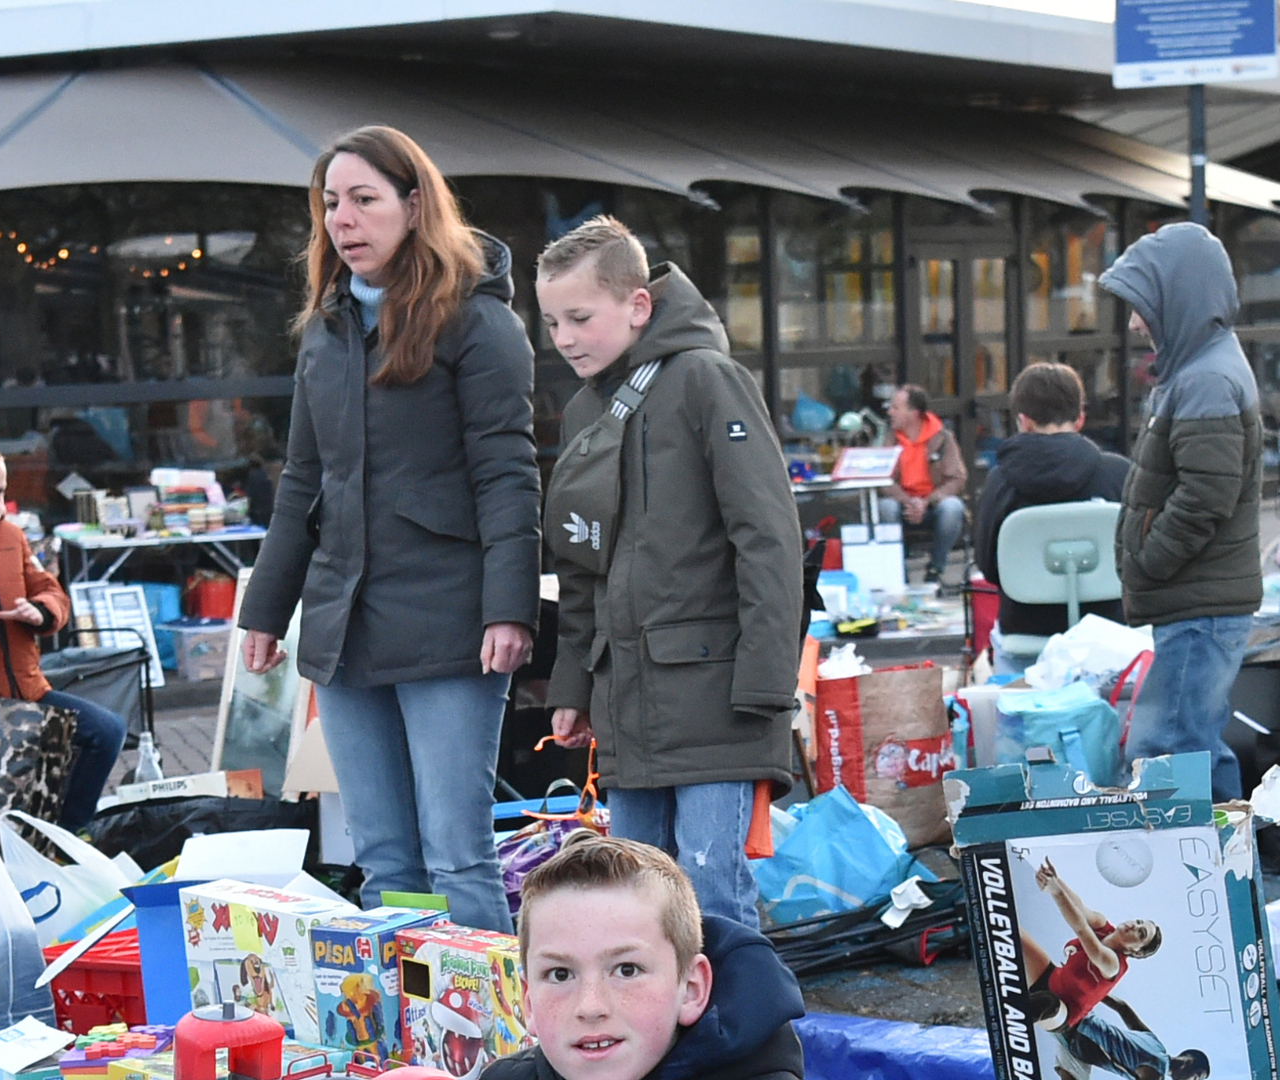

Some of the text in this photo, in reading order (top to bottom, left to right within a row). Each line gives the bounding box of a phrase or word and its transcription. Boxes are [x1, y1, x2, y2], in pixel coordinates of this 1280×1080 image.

[590, 520, 601, 551] adidas
[152, 780, 187, 793] PHILIPS
[1178, 837, 1235, 1024] EASYSET
[314, 941, 357, 966] PISA
[979, 857, 1017, 999] VOLLEYBALL
[1004, 1003, 1031, 1054] AND
[1256, 938, 1268, 995] VOLLEYBALL
[1261, 995, 1269, 1017] AND
[1263, 1017, 1276, 1070] BADMINTON
